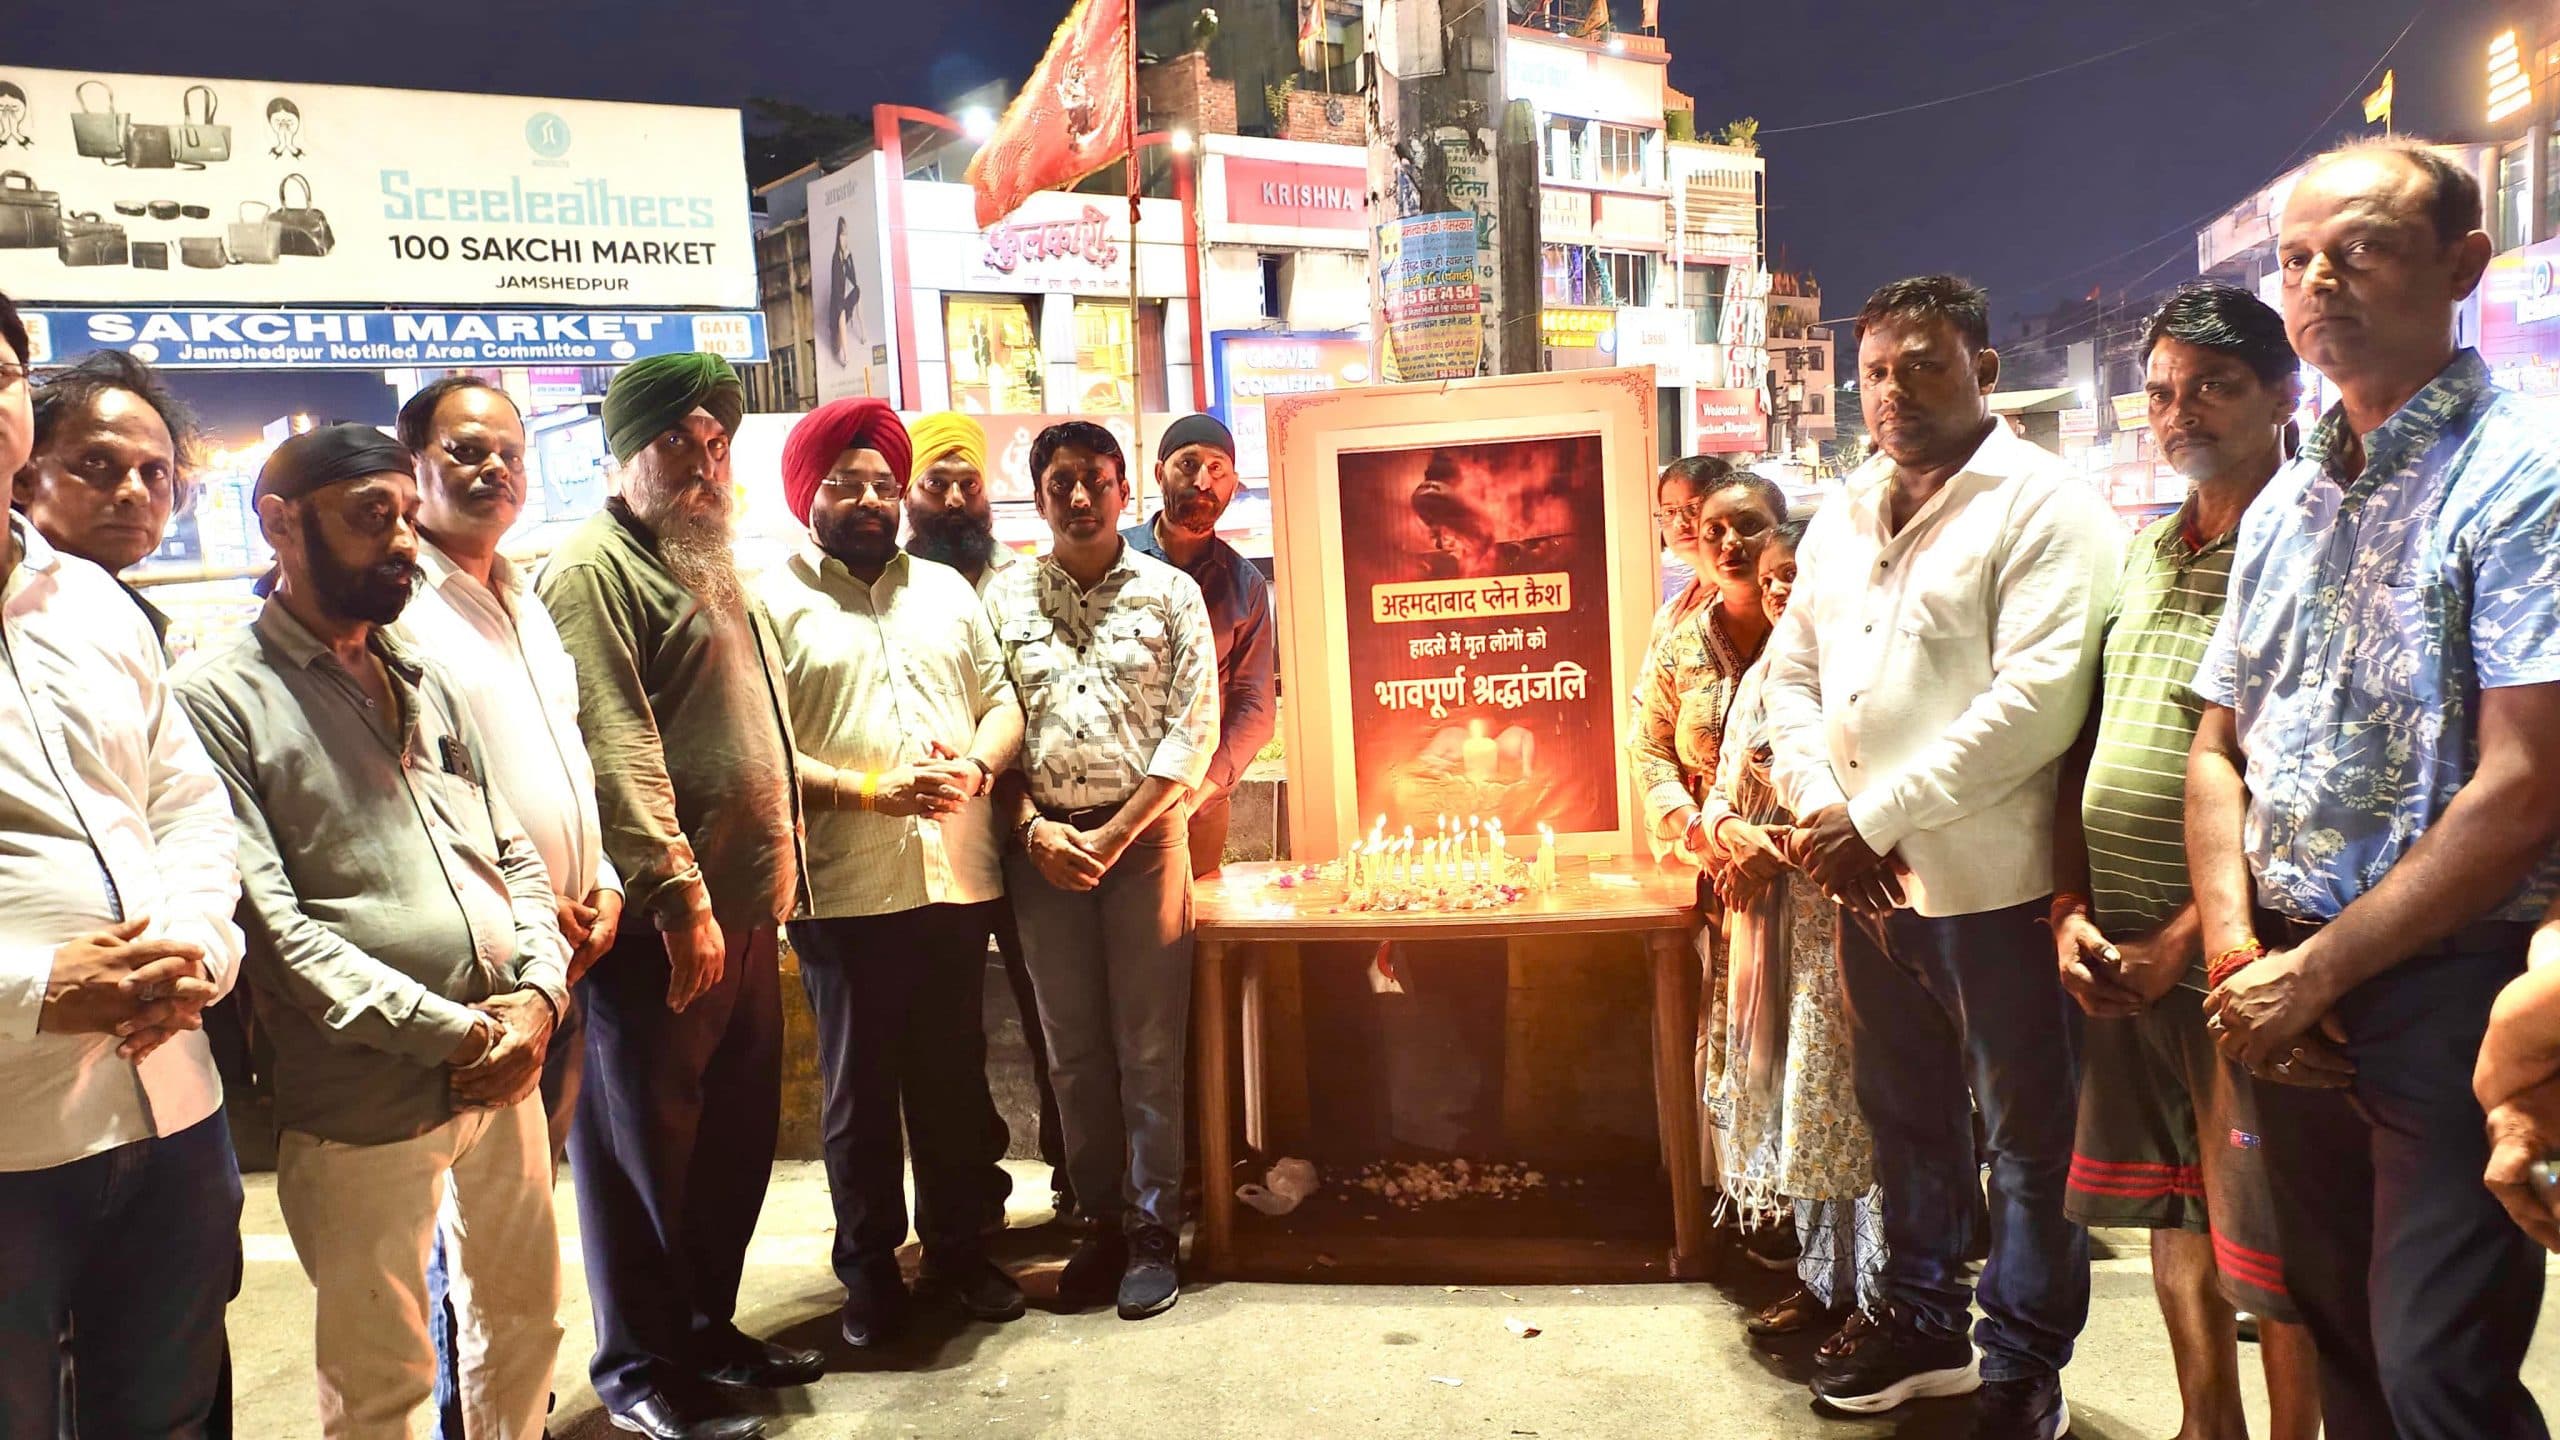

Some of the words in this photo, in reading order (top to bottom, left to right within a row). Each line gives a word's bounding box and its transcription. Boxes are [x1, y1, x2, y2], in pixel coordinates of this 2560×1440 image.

[1262, 181, 1354, 210] KRISHNA
[388, 234, 450, 261] 100
[460, 236, 582, 264] SAKCHI
[592, 240, 717, 265] MARKET
[495, 274, 630, 291] JAMSHEDPUR
[87, 313, 368, 342] SAKCHI
[392, 314, 663, 342] MARKET
[700, 320, 745, 334] GATE
[178, 343, 324, 363] Jamshedpur
[331, 343, 418, 360] Notified
[425, 344, 476, 359] Area
[482, 343, 596, 360] Committee
[1381, 589, 1477, 618] अहमदाबाद
[1482, 580, 1519, 610] प्लेन
[1524, 577, 1564, 608] क्रैश
[1409, 631, 1447, 659] हादसे
[1449, 630, 1462, 654] में
[1464, 634, 1486, 659] मृत
[1489, 627, 1524, 653] लोगों
[1527, 626, 1548, 650] को
[1374, 664, 1467, 719] भावपूर्ण
[1472, 660, 1588, 710] श्रद्धांजलि
